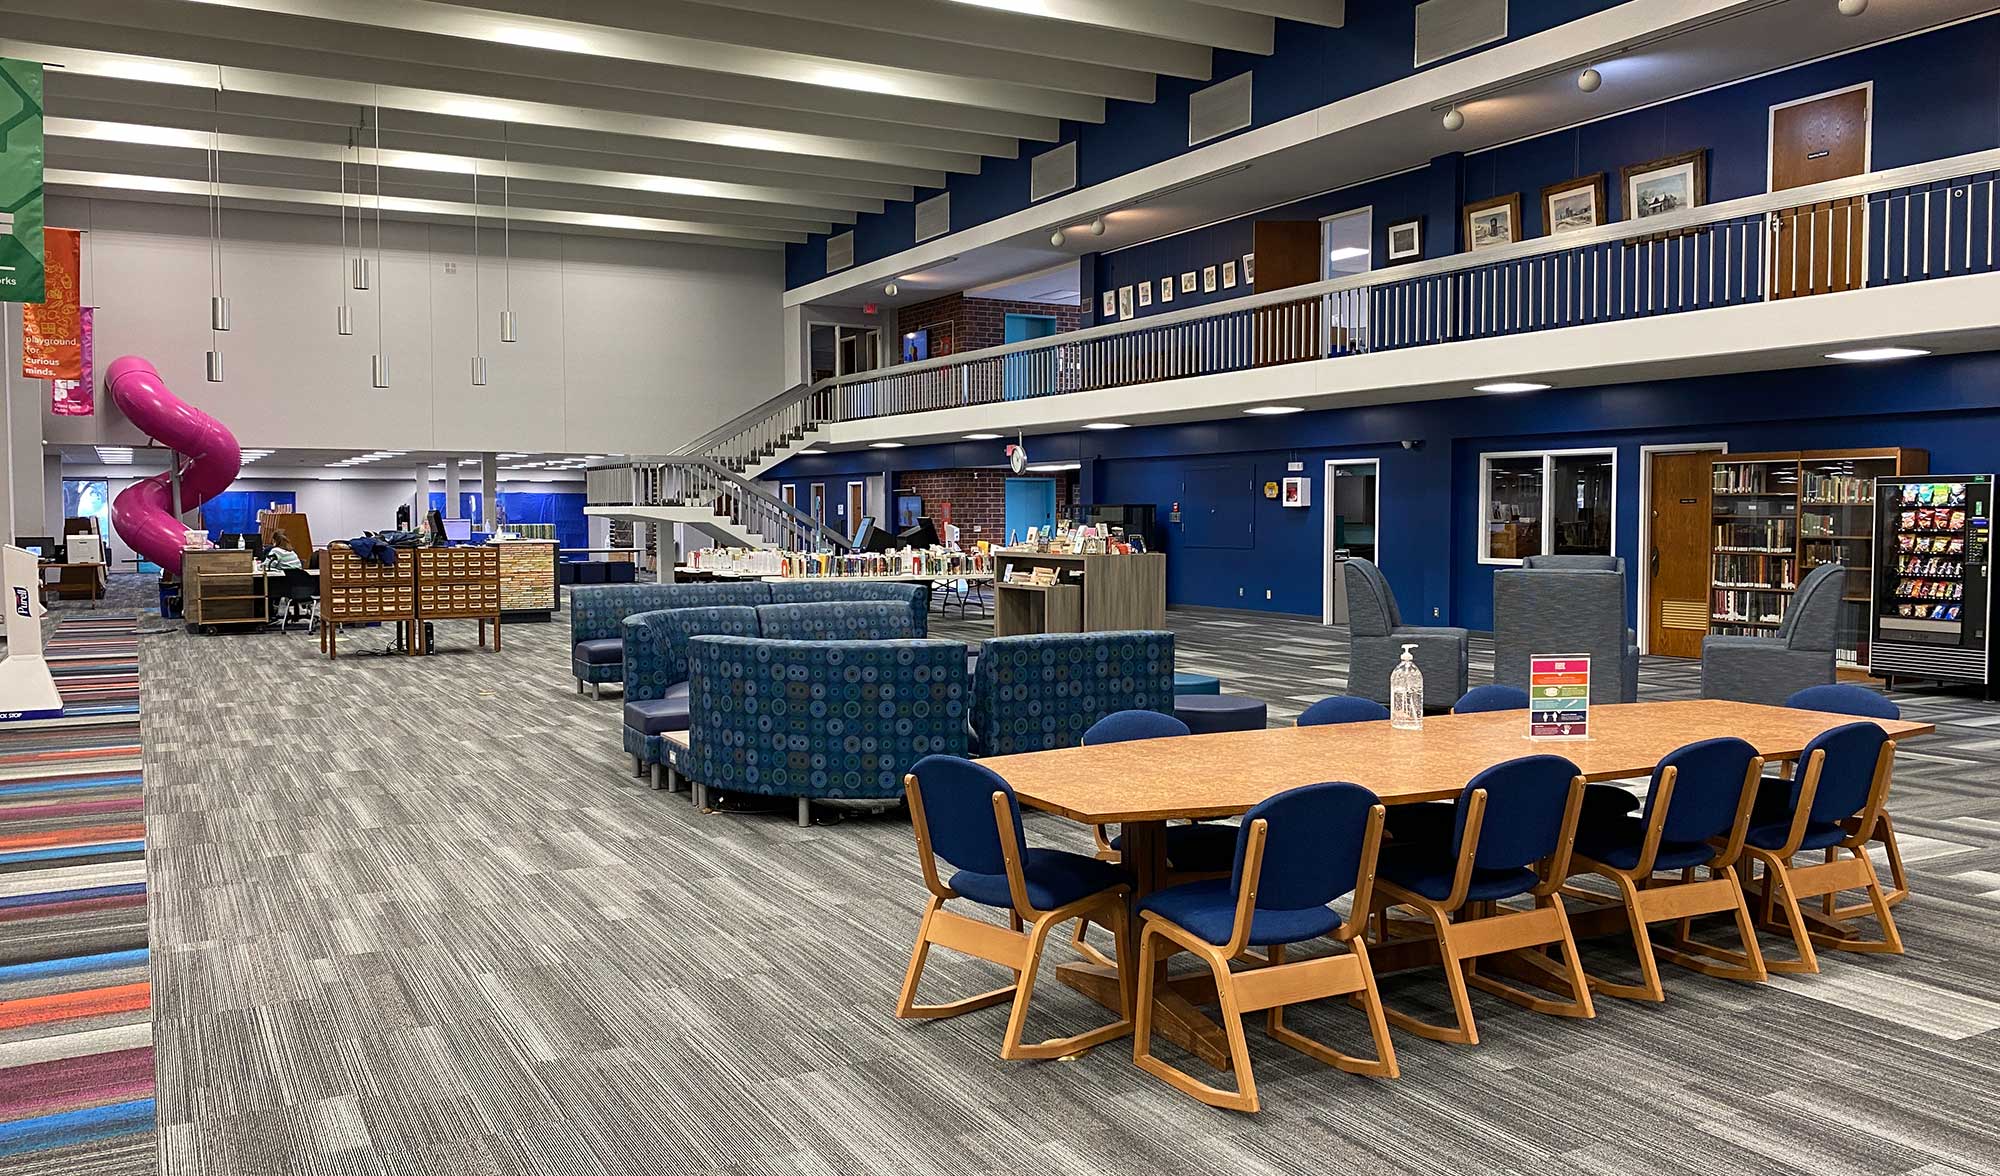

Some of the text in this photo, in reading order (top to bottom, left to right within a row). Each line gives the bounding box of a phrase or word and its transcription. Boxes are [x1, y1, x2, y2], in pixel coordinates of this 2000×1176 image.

[0, 276, 17, 286] rks
[26, 336, 77, 346] playground
[26, 345, 40, 354] for
[26, 357, 60, 366] curious
[25, 367, 57, 376] minds.
[17, 589, 28, 614] Purell
